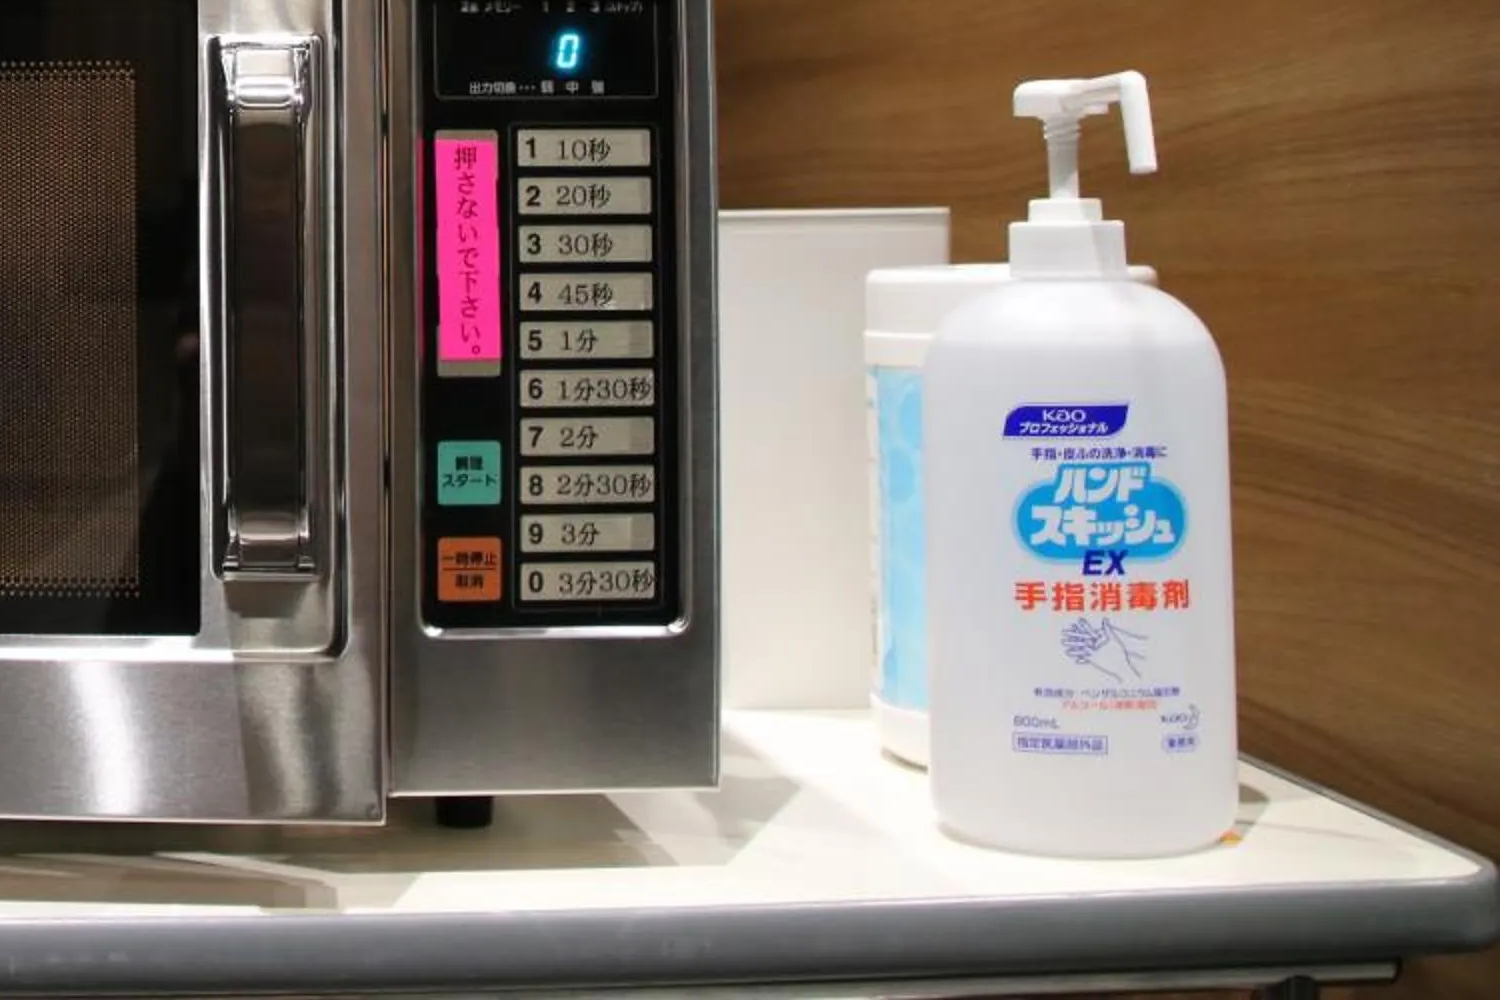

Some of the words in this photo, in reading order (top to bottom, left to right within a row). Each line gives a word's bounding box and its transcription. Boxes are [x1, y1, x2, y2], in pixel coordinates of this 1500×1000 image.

[556, 33, 580, 69] 0
[525, 137, 537, 159] 1
[558, 137, 611, 162] 10秒
[525, 185, 541, 207] 2
[556, 184, 611, 208] 20秒
[454, 146, 481, 355] 押さないで下さい。
[526, 233, 542, 255] 3
[558, 233, 613, 256] 30秒
[527, 281, 542, 302] 4
[559, 283, 613, 306] 45秒
[527, 330, 543, 351] 5
[562, 328, 598, 353] 1分
[528, 378, 543, 399] 6
[560, 377, 651, 401] 1分30秒
[529, 427, 543, 448] 7
[560, 425, 598, 449] 2分
[1019, 421, 1108, 435] プロフェッショナル
[442, 473, 497, 488] スタート
[528, 474, 543, 496] 8
[556, 473, 651, 497] 2分30秒
[1054, 463, 1150, 504] ハンド
[528, 523, 543, 544] 9
[561, 521, 599, 546] 3分
[1030, 503, 1176, 546] スキッシュ
[1082, 549, 1128, 576] EX
[528, 571, 543, 593] 0
[558, 568, 655, 594] 3分30秒
[1014, 580, 1190, 612] 手指消毒剤
